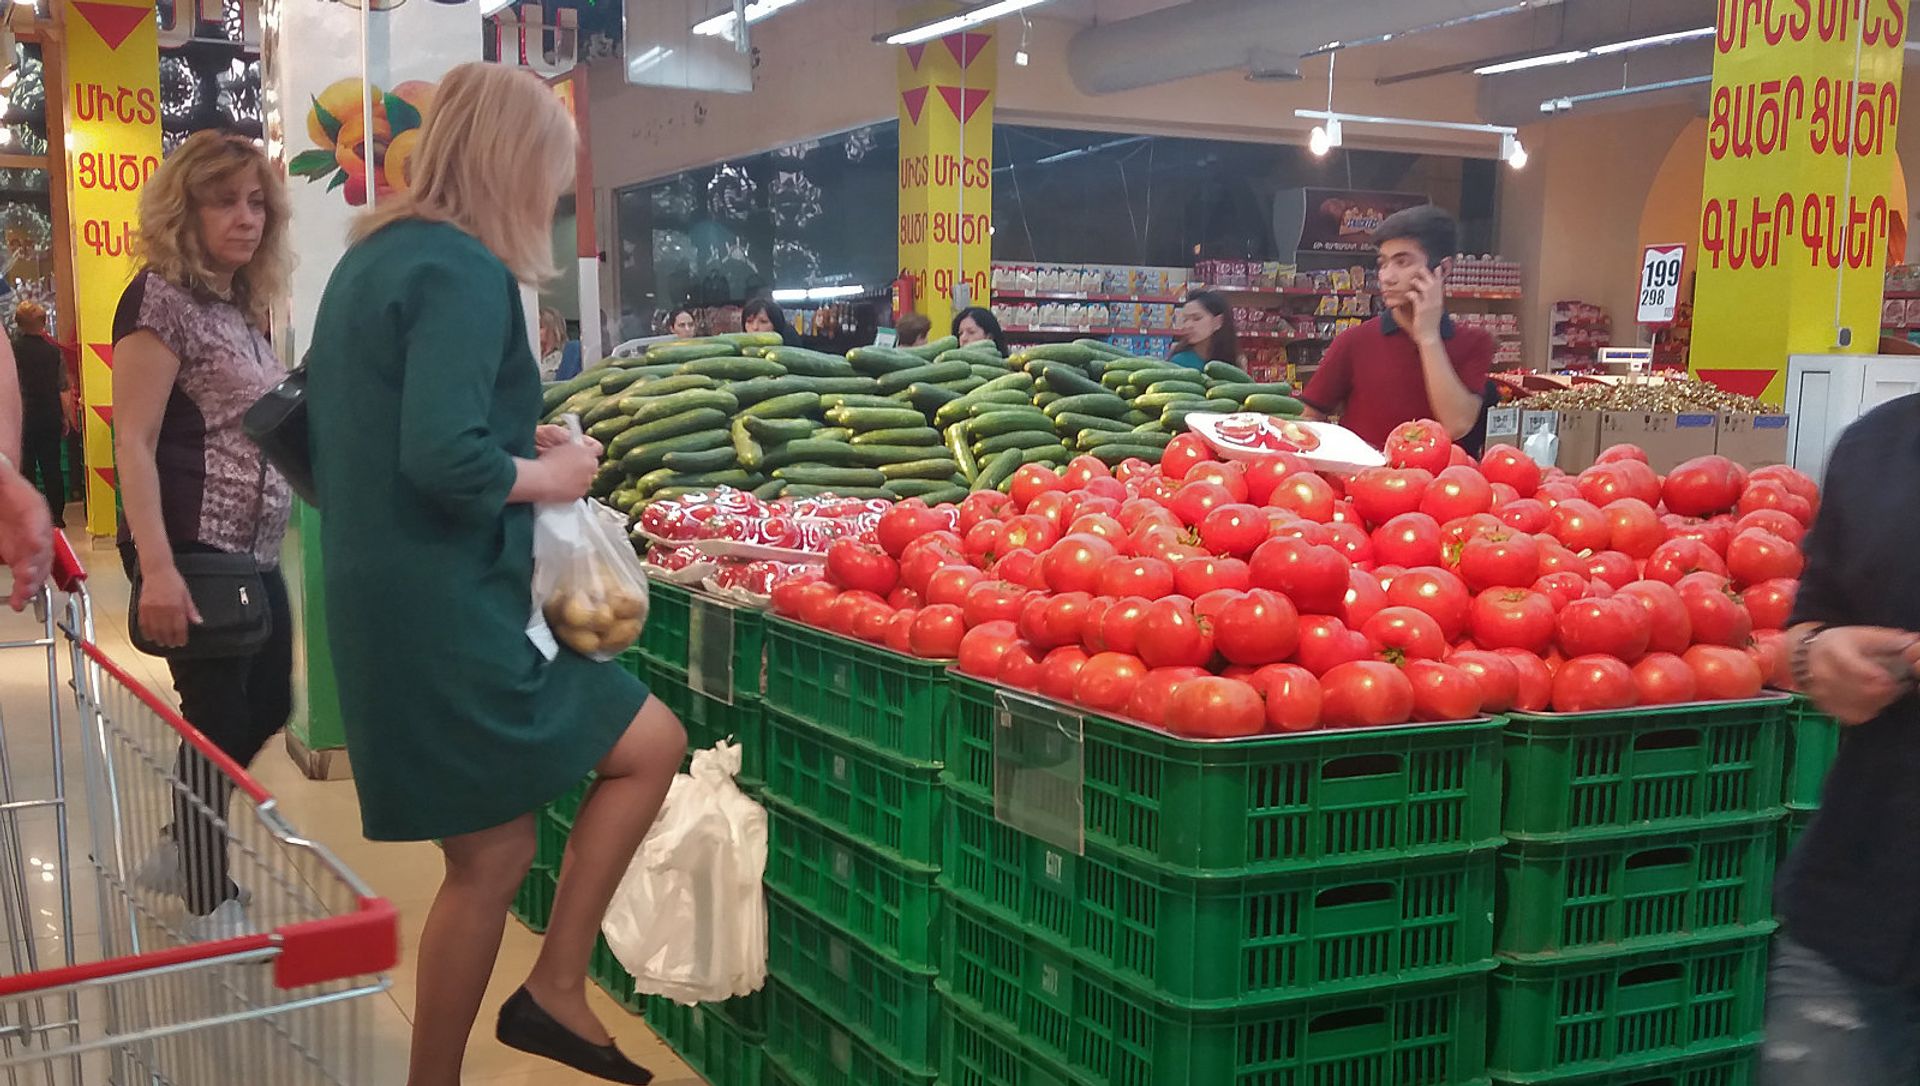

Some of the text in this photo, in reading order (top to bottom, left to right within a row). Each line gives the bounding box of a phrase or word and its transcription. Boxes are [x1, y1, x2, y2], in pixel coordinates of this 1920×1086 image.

[75, 83, 156, 125] ՄԻՇՏ
[1709, 75, 1805, 160] ՑԱԾՐ
[1809, 76, 1897, 159] ՑԱԾՐ
[901, 155, 929, 189] ՄԻՇՏ
[934, 154, 990, 189] ՄԻՇՏ
[900, 213, 928, 245] ՑԱԾՐ
[933, 212, 990, 245] ՑԱԾՐ
[1702, 192, 1795, 270] ԳՆԵՐ
[1801, 192, 1887, 270] ԳՆԵՐ
[1646, 259, 1680, 288] 199
[1641, 288, 1665, 306] 298
